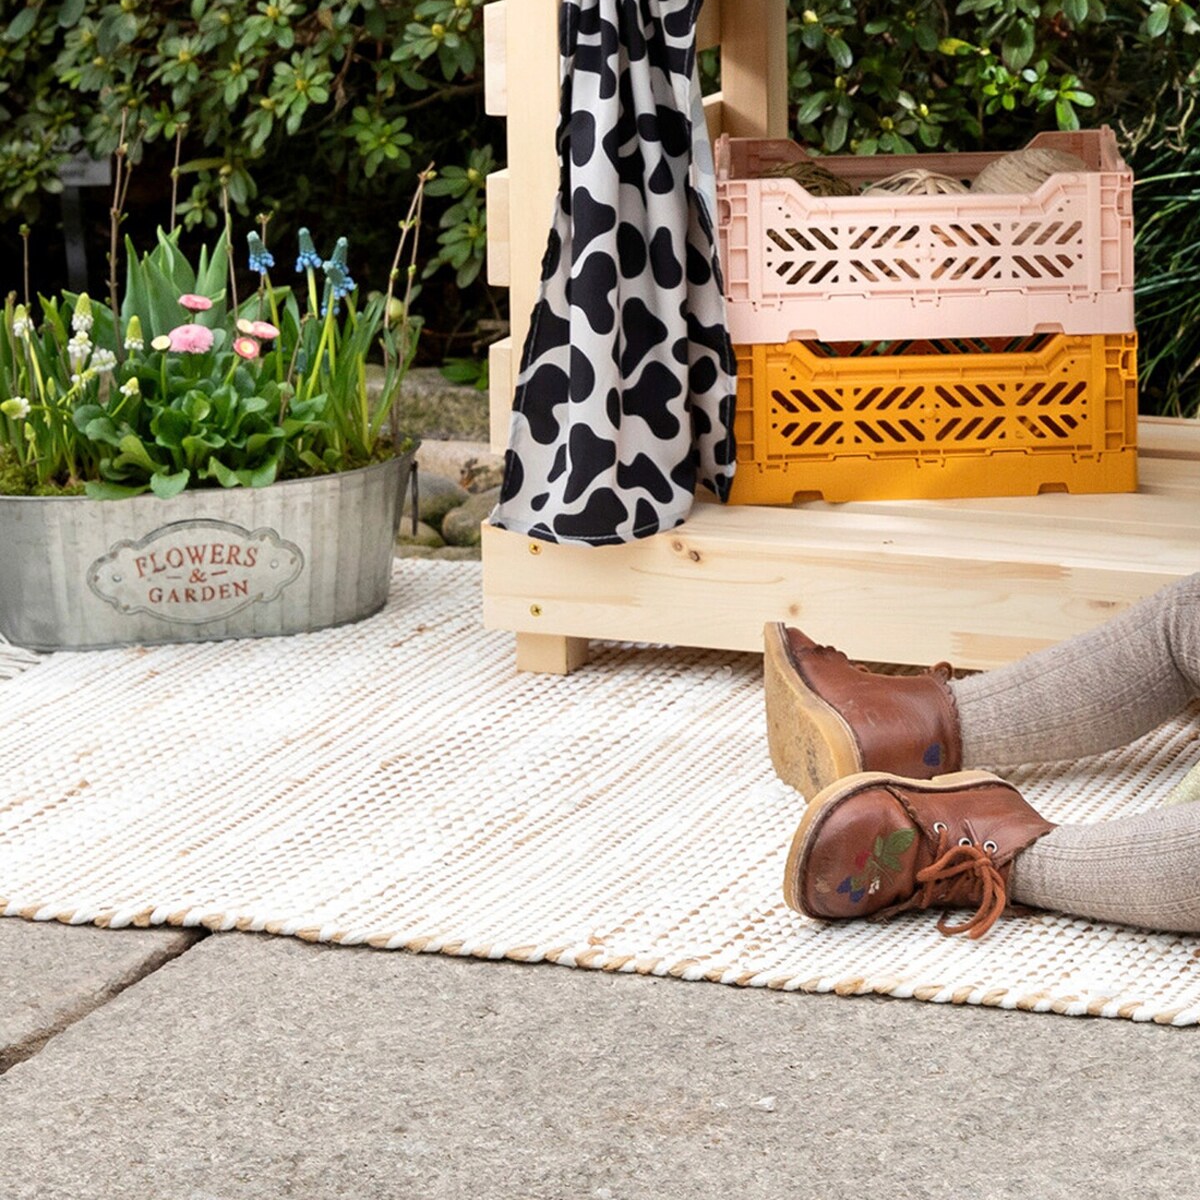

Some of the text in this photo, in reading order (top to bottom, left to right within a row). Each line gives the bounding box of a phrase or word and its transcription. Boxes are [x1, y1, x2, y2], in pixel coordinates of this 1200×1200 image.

[134, 544, 258, 578] FLOWERS
[188, 569, 207, 584] &
[148, 580, 249, 604] GARDEN
